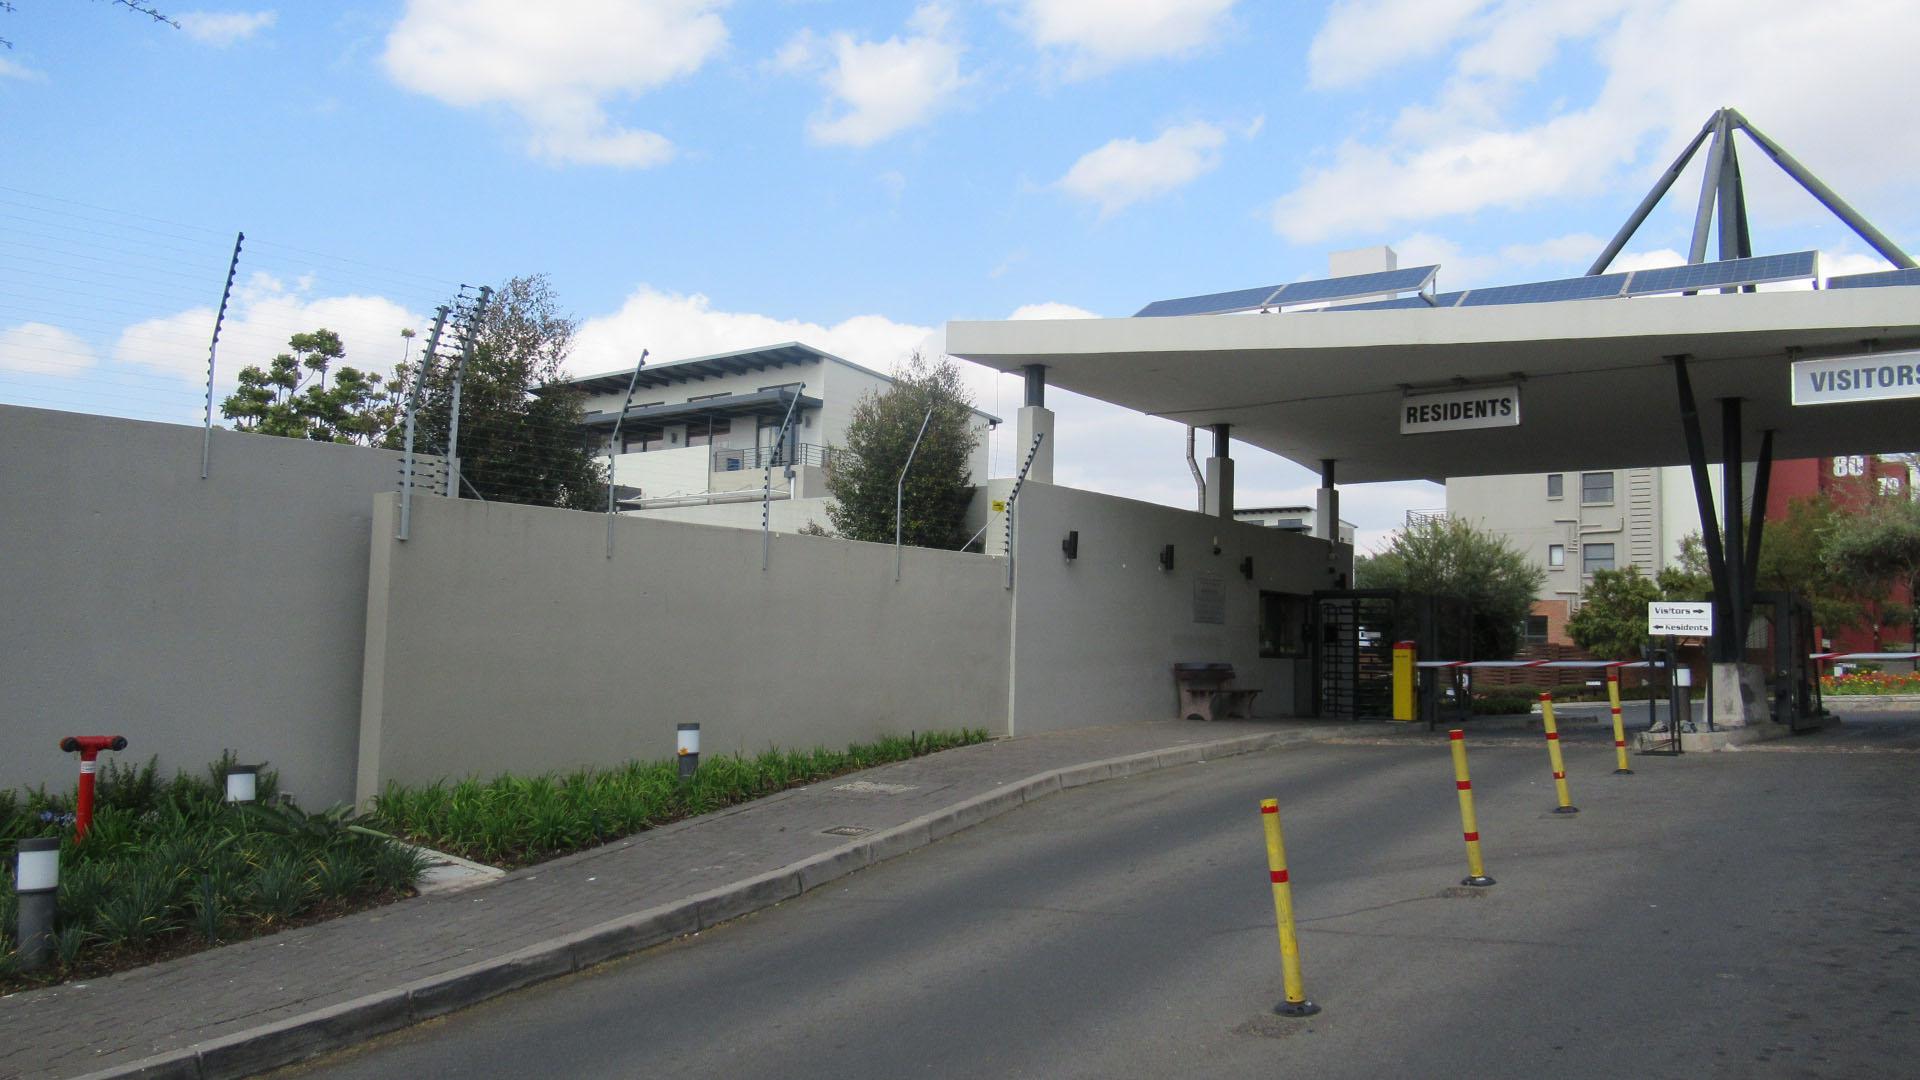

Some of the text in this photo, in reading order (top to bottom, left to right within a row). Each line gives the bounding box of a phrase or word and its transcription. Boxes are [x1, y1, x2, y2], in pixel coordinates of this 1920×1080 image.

[1406, 398, 1511, 423] RESIDENTS
[1833, 455, 1863, 477] 80
[1655, 606, 1691, 614] Visitors
[1665, 623, 1709, 631] Residents
